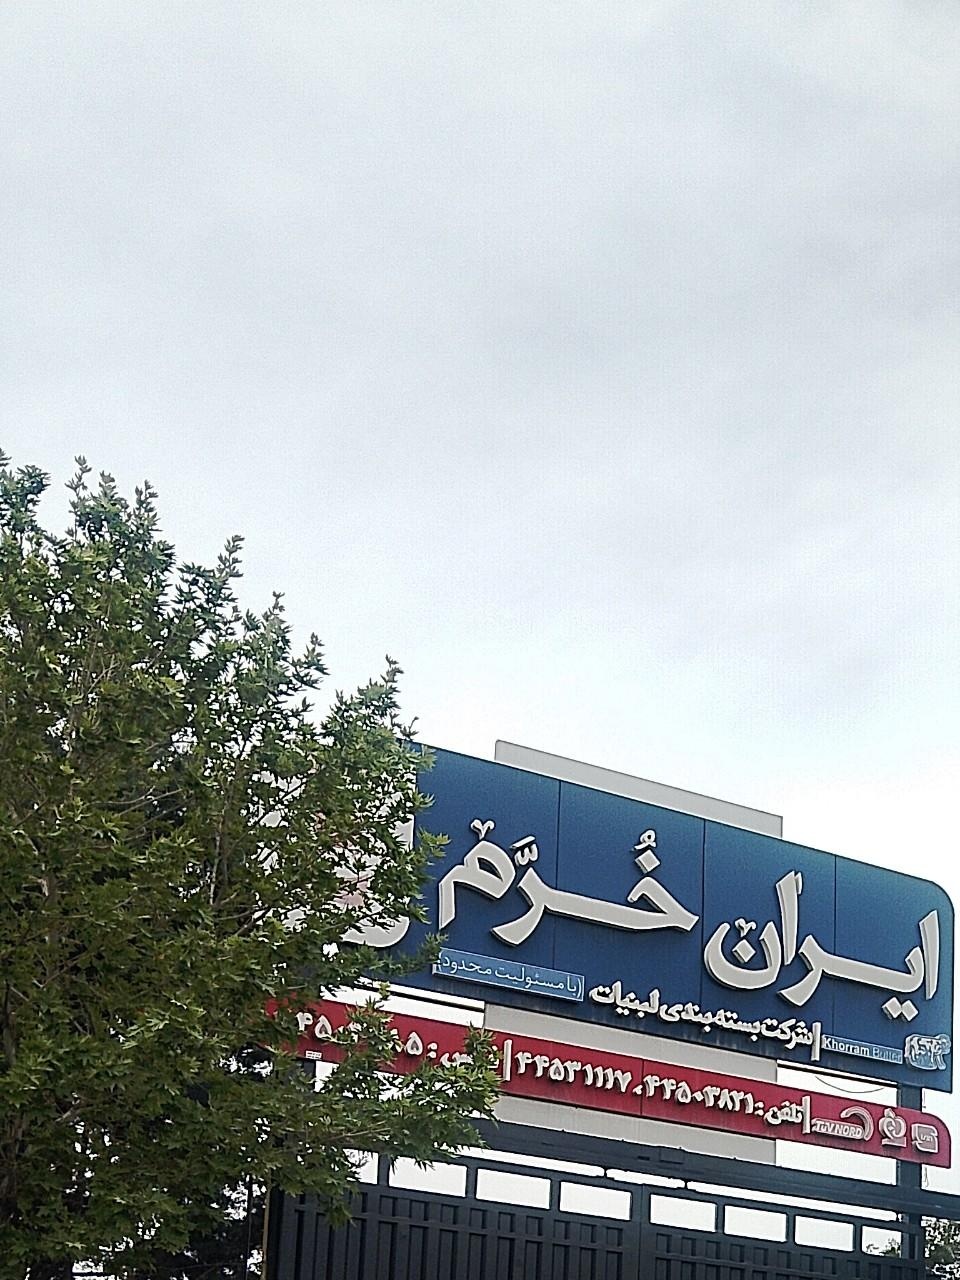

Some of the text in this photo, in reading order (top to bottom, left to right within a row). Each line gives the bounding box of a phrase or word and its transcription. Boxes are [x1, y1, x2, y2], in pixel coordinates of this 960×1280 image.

[704, 869, 941, 1023] ایران
[494, 966, 565, 989] مسئولیت
[589, 980, 660, 1018] لبنیات
[714, 1008, 762, 1041] بسته
[761, 1017, 814, 1050] شرکت
[824, 1036, 870, 1056] Khorram
[834, 1124, 863, 1138] NORD
